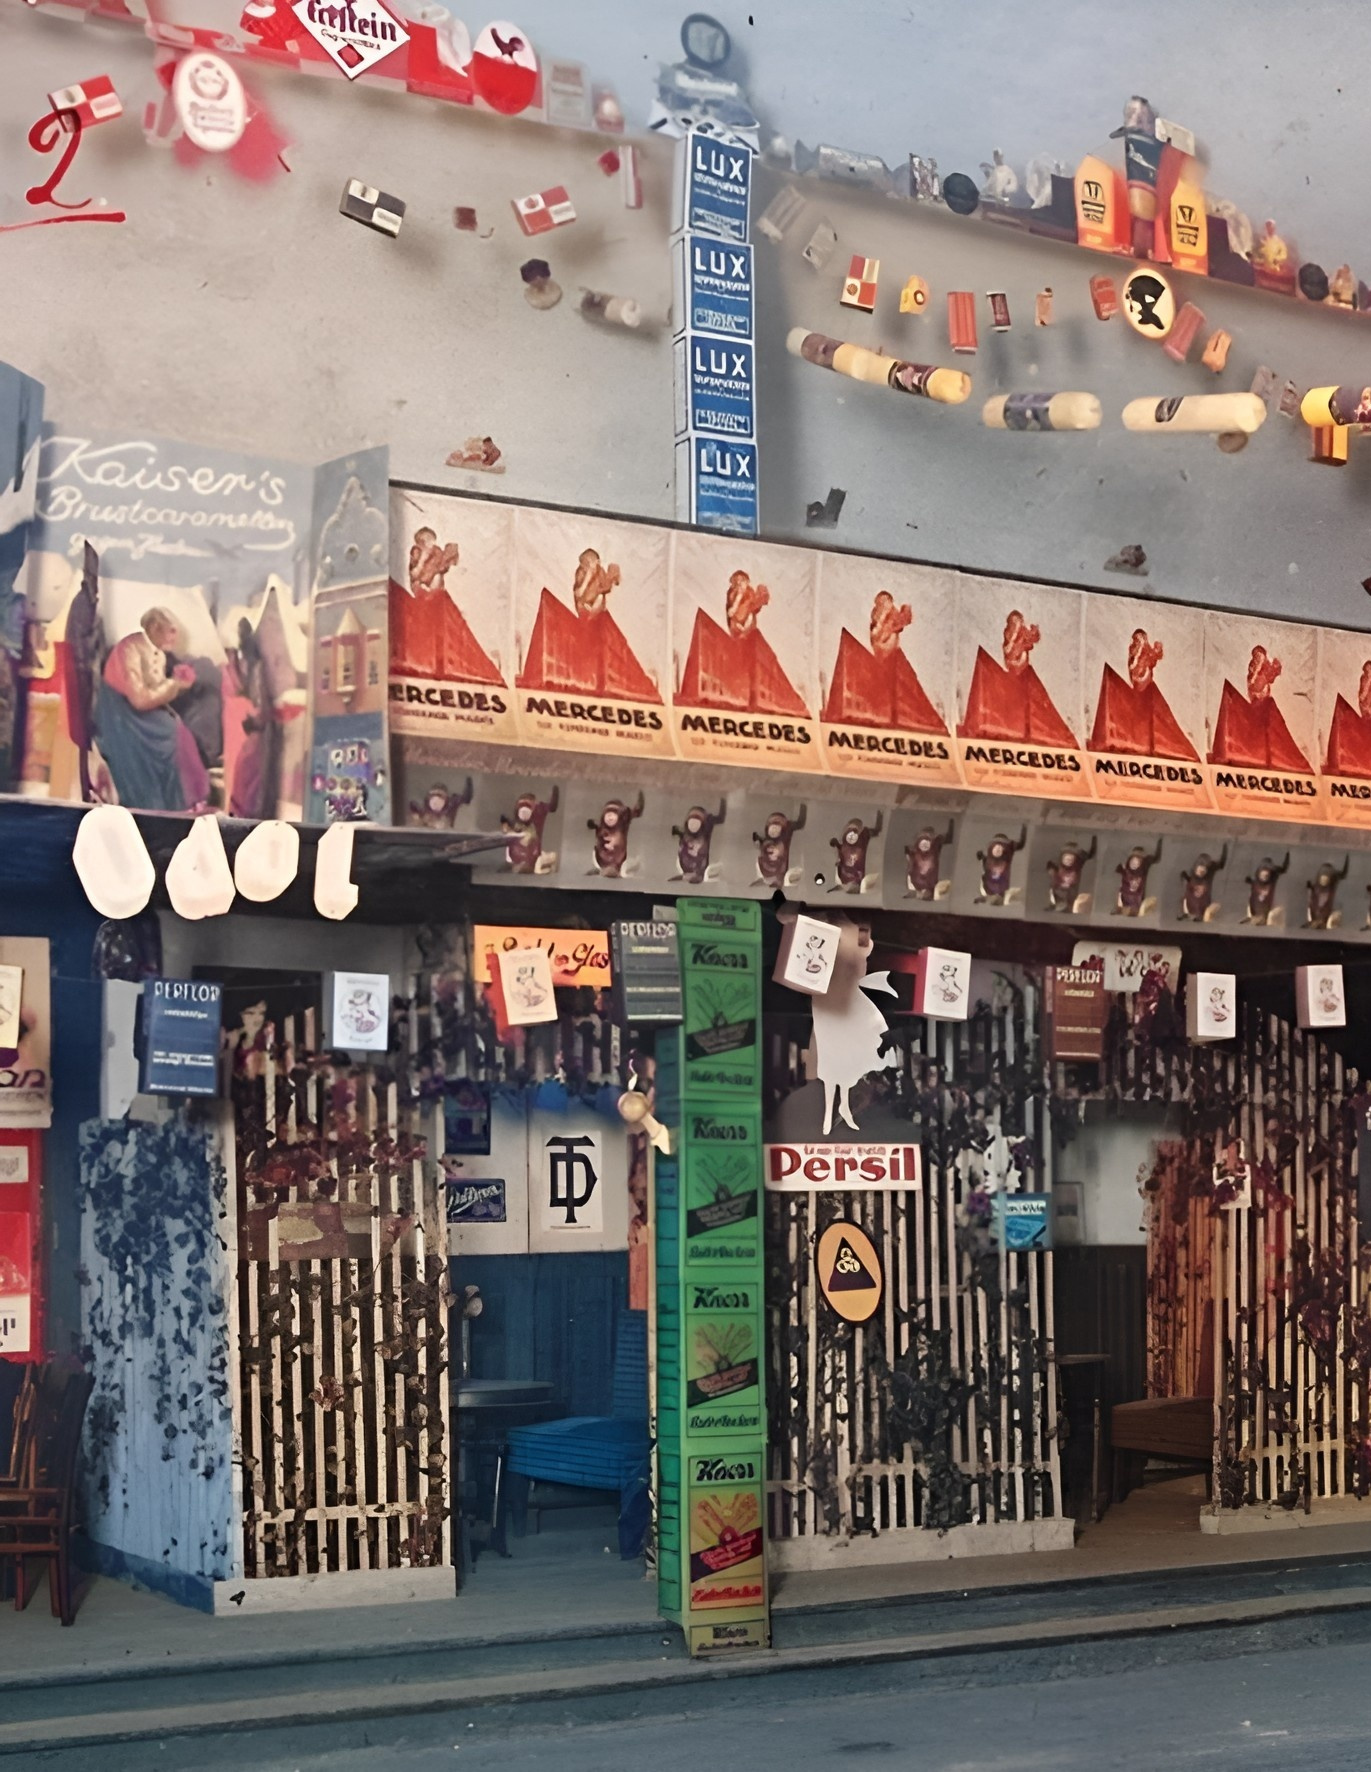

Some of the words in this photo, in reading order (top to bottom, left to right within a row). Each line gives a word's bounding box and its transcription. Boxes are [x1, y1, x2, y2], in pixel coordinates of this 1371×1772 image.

[696, 145, 744, 182] LUX
[695, 247, 745, 279] LUX
[695, 347, 746, 378] LUX
[23, 434, 286, 505] Kaiser's
[701, 448, 750, 477] LUX
[526, 697, 663, 730] MERCEDES
[682, 714, 811, 744] MERCEDES
[828, 731, 949, 760] MERCEDES
[966, 746, 1080, 771] MERCEDES
[1096, 759, 1203, 785] MERCEDES
[770, 1147, 916, 1182] Persil
